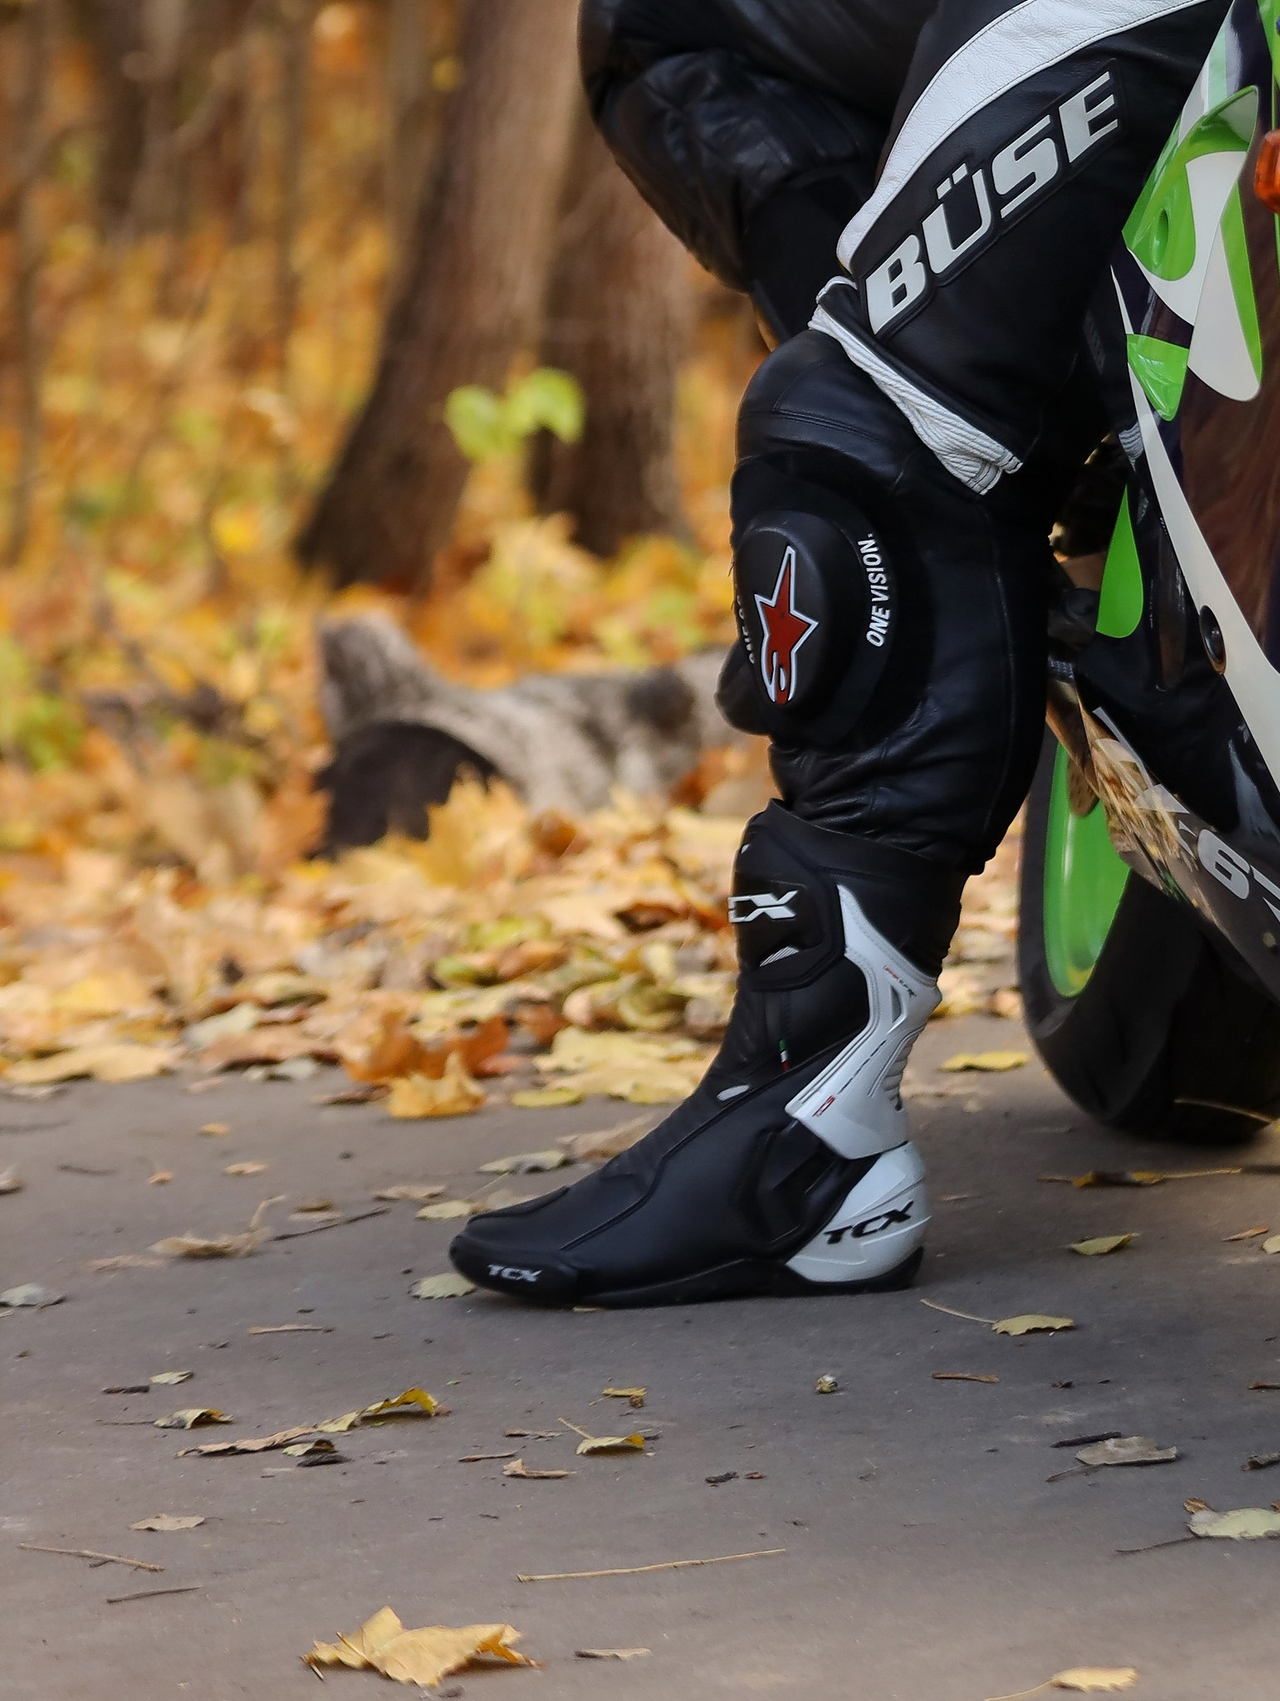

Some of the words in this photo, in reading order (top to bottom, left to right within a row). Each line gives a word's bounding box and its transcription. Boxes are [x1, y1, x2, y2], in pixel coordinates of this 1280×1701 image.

[865, 70, 1119, 336] BÜSE
[865, 604, 891, 648] ONE
[727, 890, 799, 923] CX
[823, 1200, 915, 1245] TCX
[487, 1264, 543, 1282] TCX
